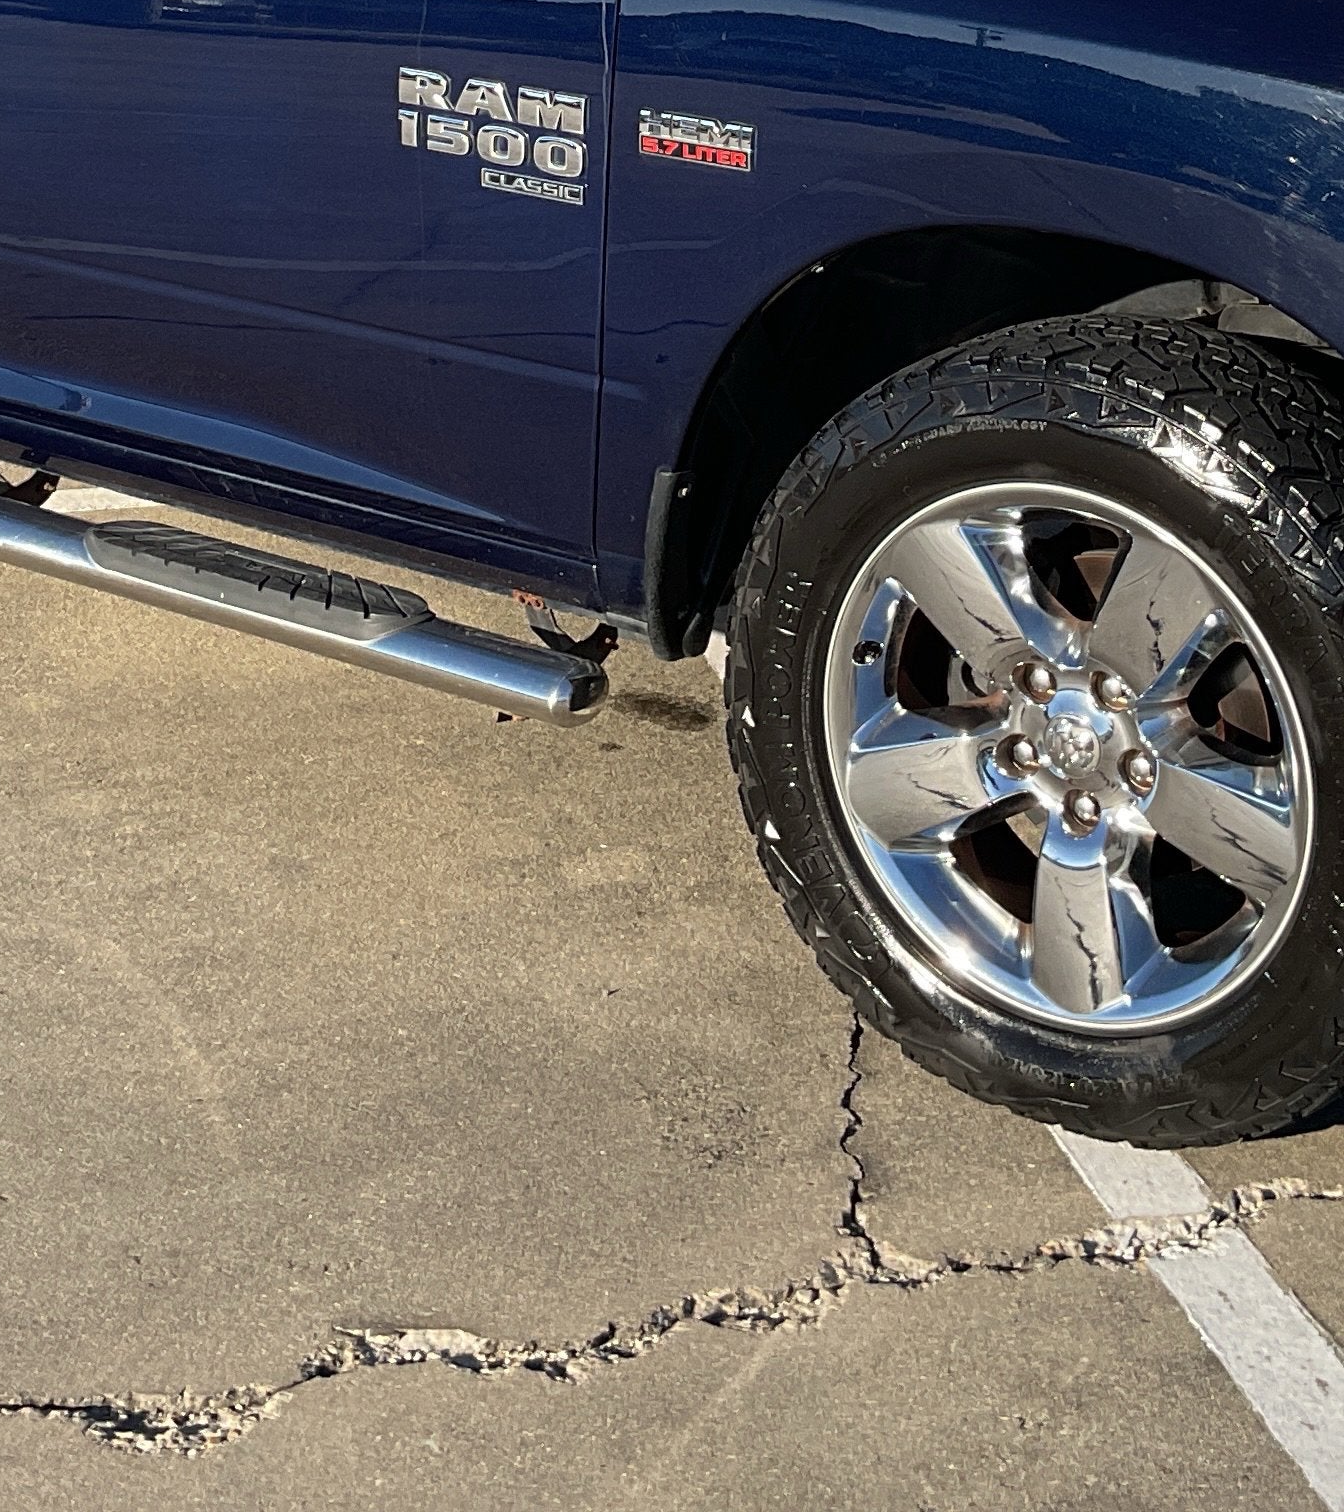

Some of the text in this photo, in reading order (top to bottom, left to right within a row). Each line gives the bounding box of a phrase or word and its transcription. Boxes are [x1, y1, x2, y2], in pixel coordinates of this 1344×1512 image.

[398, 65, 591, 136] RAM
[638, 107, 757, 150] HEMI
[397, 108, 588, 179] 1500
[641, 135, 748, 169] 5.7 LITER
[482, 170, 584, 204] CLASSIC
[766, 570, 815, 729] POWER
